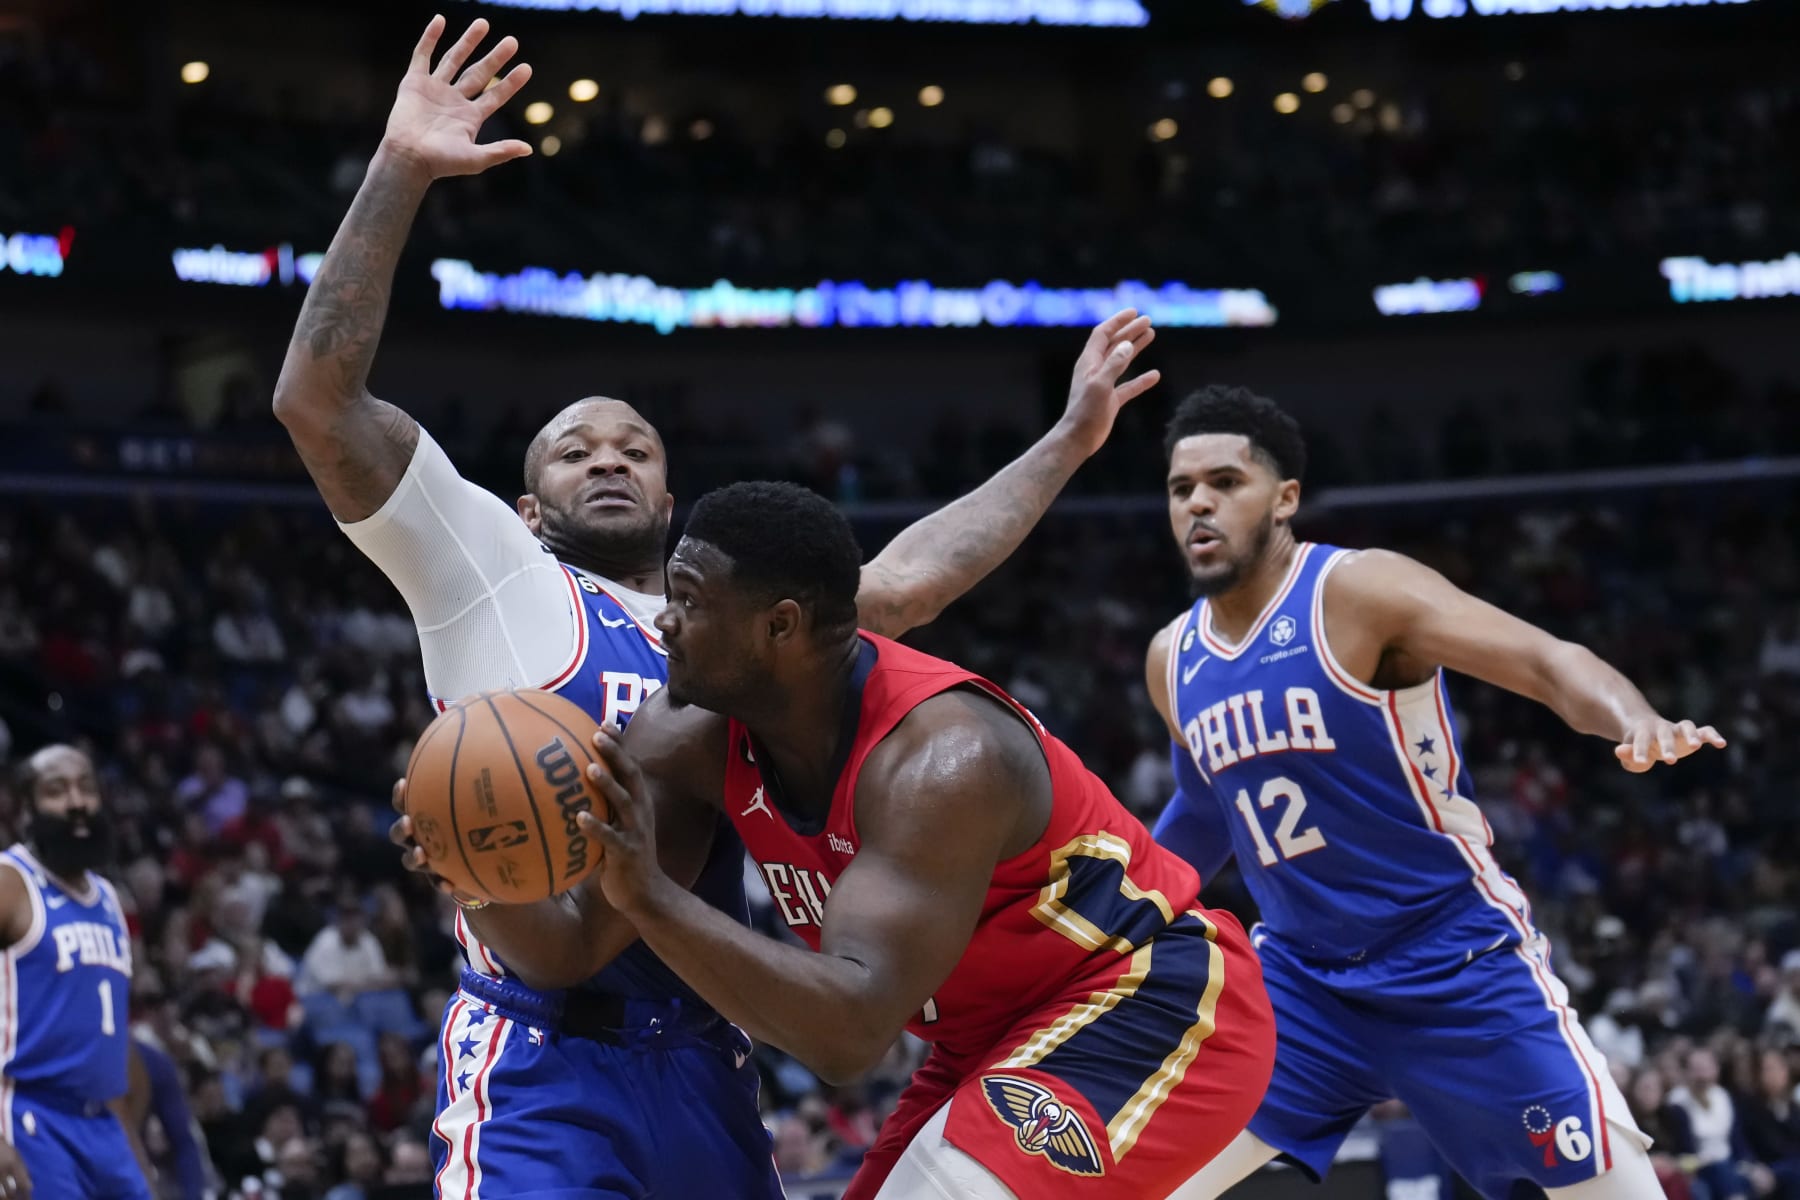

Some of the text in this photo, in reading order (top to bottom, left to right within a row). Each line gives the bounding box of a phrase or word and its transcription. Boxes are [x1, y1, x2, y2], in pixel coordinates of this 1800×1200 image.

[1260, 645, 1308, 664] crypto.com
[1184, 687, 1336, 780] PHILA
[535, 735, 593, 880] Wilson
[1235, 776, 1327, 867] 12
[98, 978, 115, 1036] 1
[1526, 1114, 1592, 1169] 76
